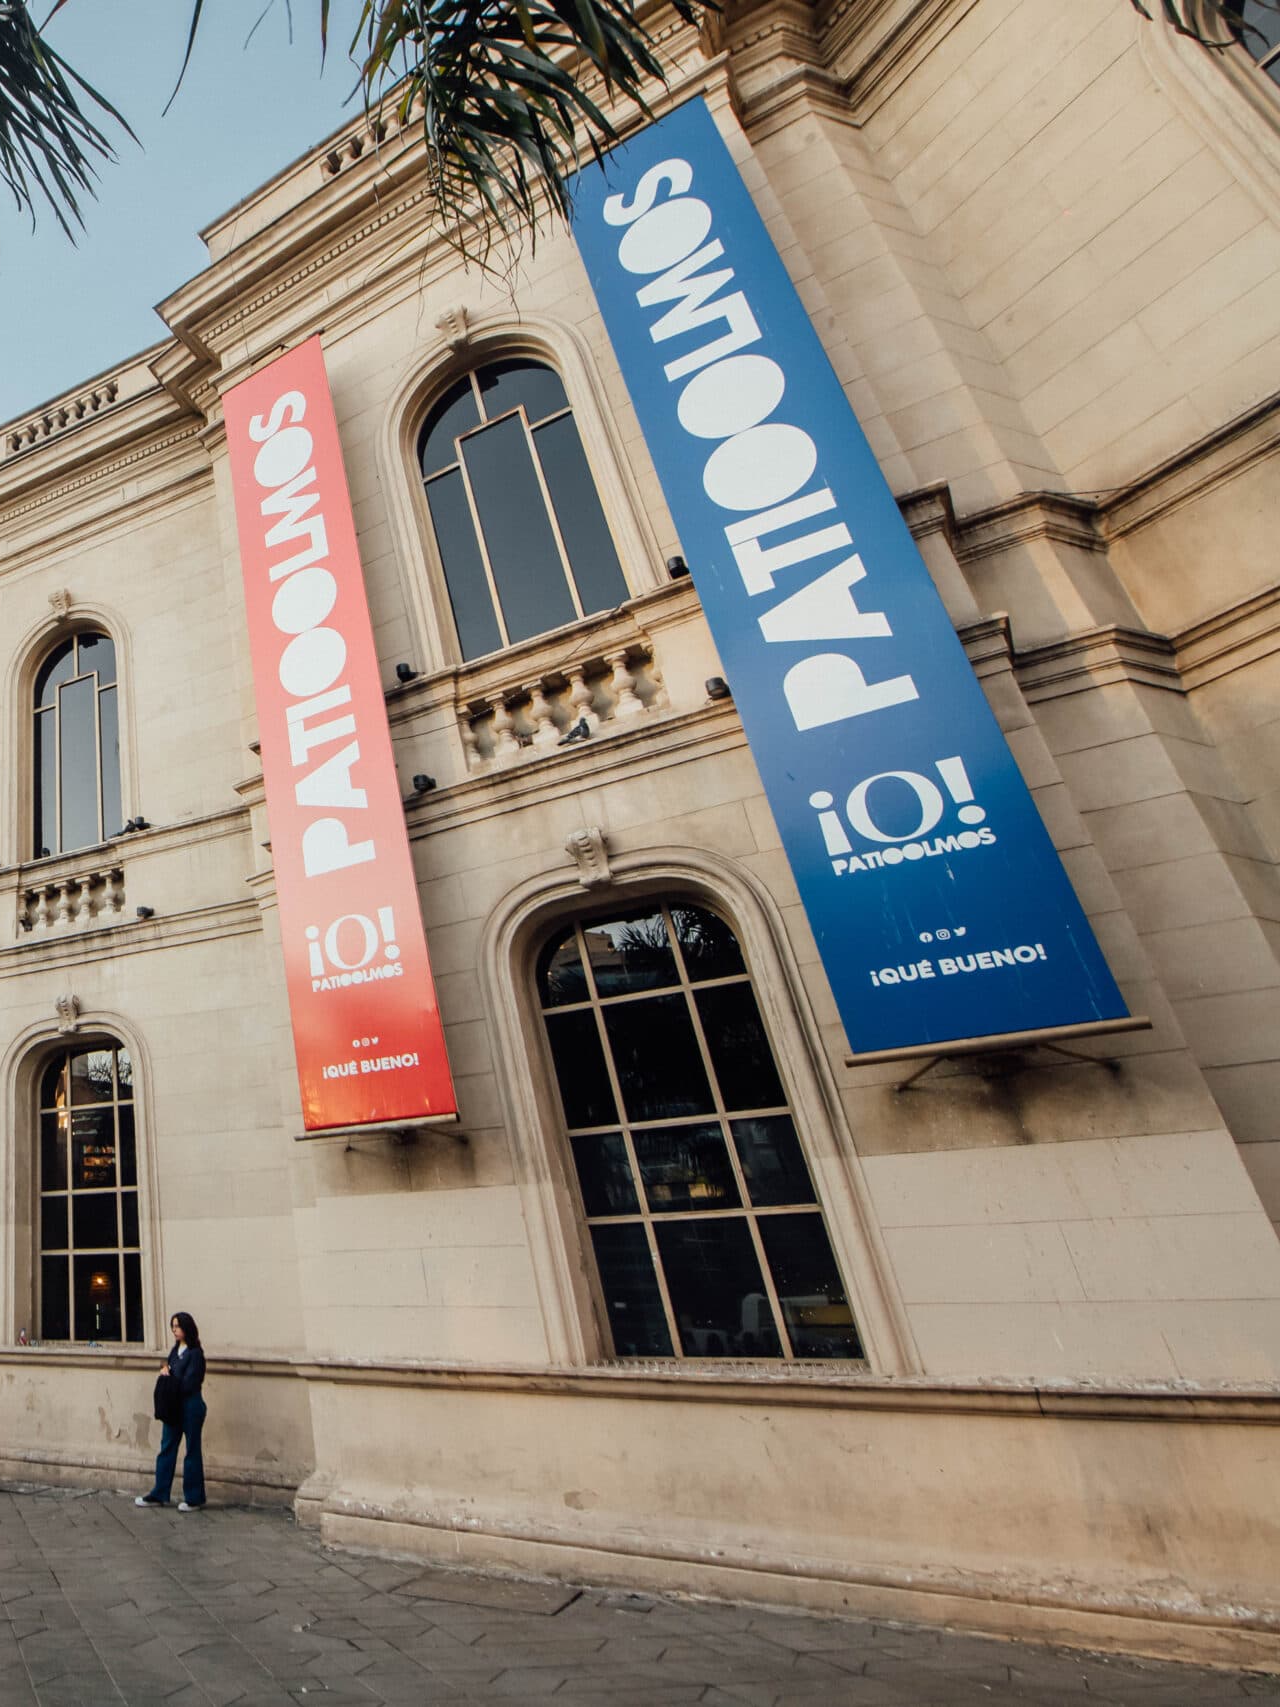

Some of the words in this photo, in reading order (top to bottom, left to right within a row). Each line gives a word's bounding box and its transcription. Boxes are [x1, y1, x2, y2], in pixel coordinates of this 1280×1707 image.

[603, 158, 919, 731] PATIOOLMOS
[249, 390, 376, 878] PATIOOLMOS
[809, 756, 986, 857] ¡O!
[831, 827, 997, 876] PATIOOLMOS
[305, 906, 400, 977] ¡O!
[870, 958, 935, 987] ¡QUÉ
[940, 943, 1048, 977] BUENO!
[312, 962, 403, 992] PATIOOLMOS
[322, 1059, 357, 1080] ¡QUÉ
[361, 1052, 420, 1074] BUENO!
